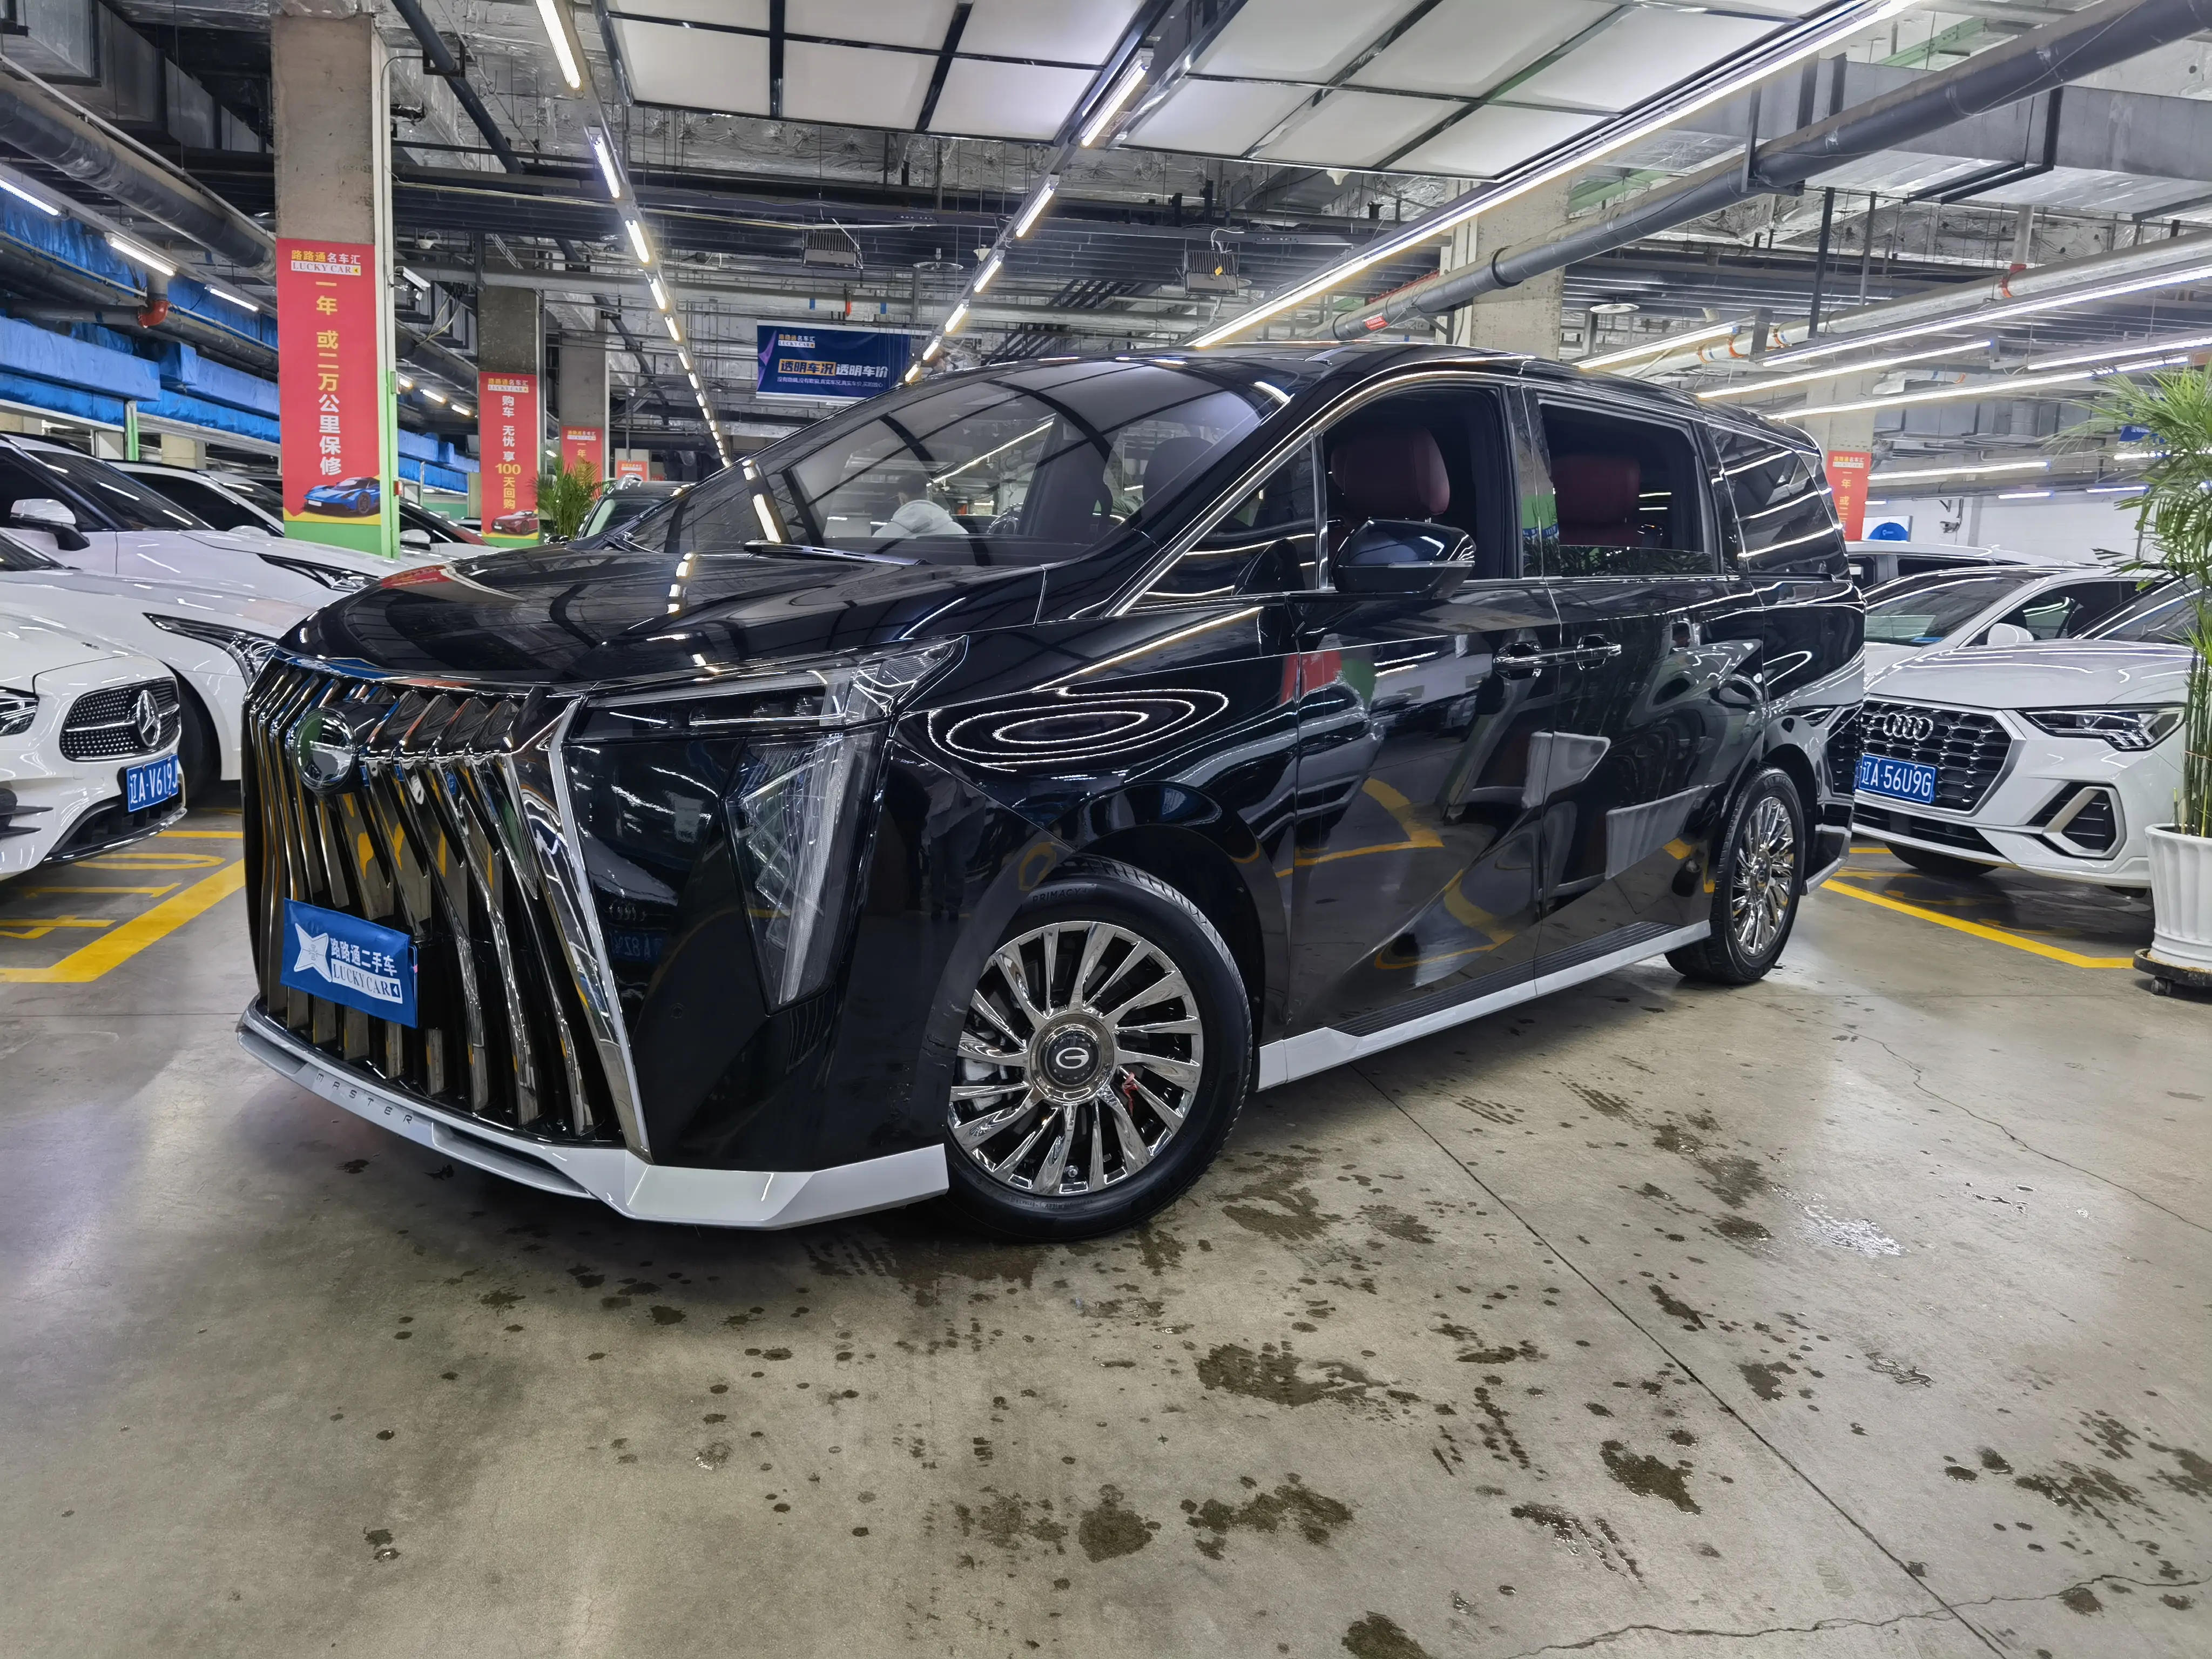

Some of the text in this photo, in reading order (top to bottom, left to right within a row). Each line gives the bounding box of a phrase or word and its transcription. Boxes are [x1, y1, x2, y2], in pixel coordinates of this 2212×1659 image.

[292, 250, 361, 265] 路路通名车汇
[293, 262, 352, 273] LUCKY CAR
[781, 361, 889, 377] 透明车况 透明车价
[1033, 888, 1081, 903] PRIMACY
[330, 938, 397, 976] 路路通二手车
[333, 964, 391, 996] LUCKY CAR
[316, 1073, 413, 1124] MASTER
